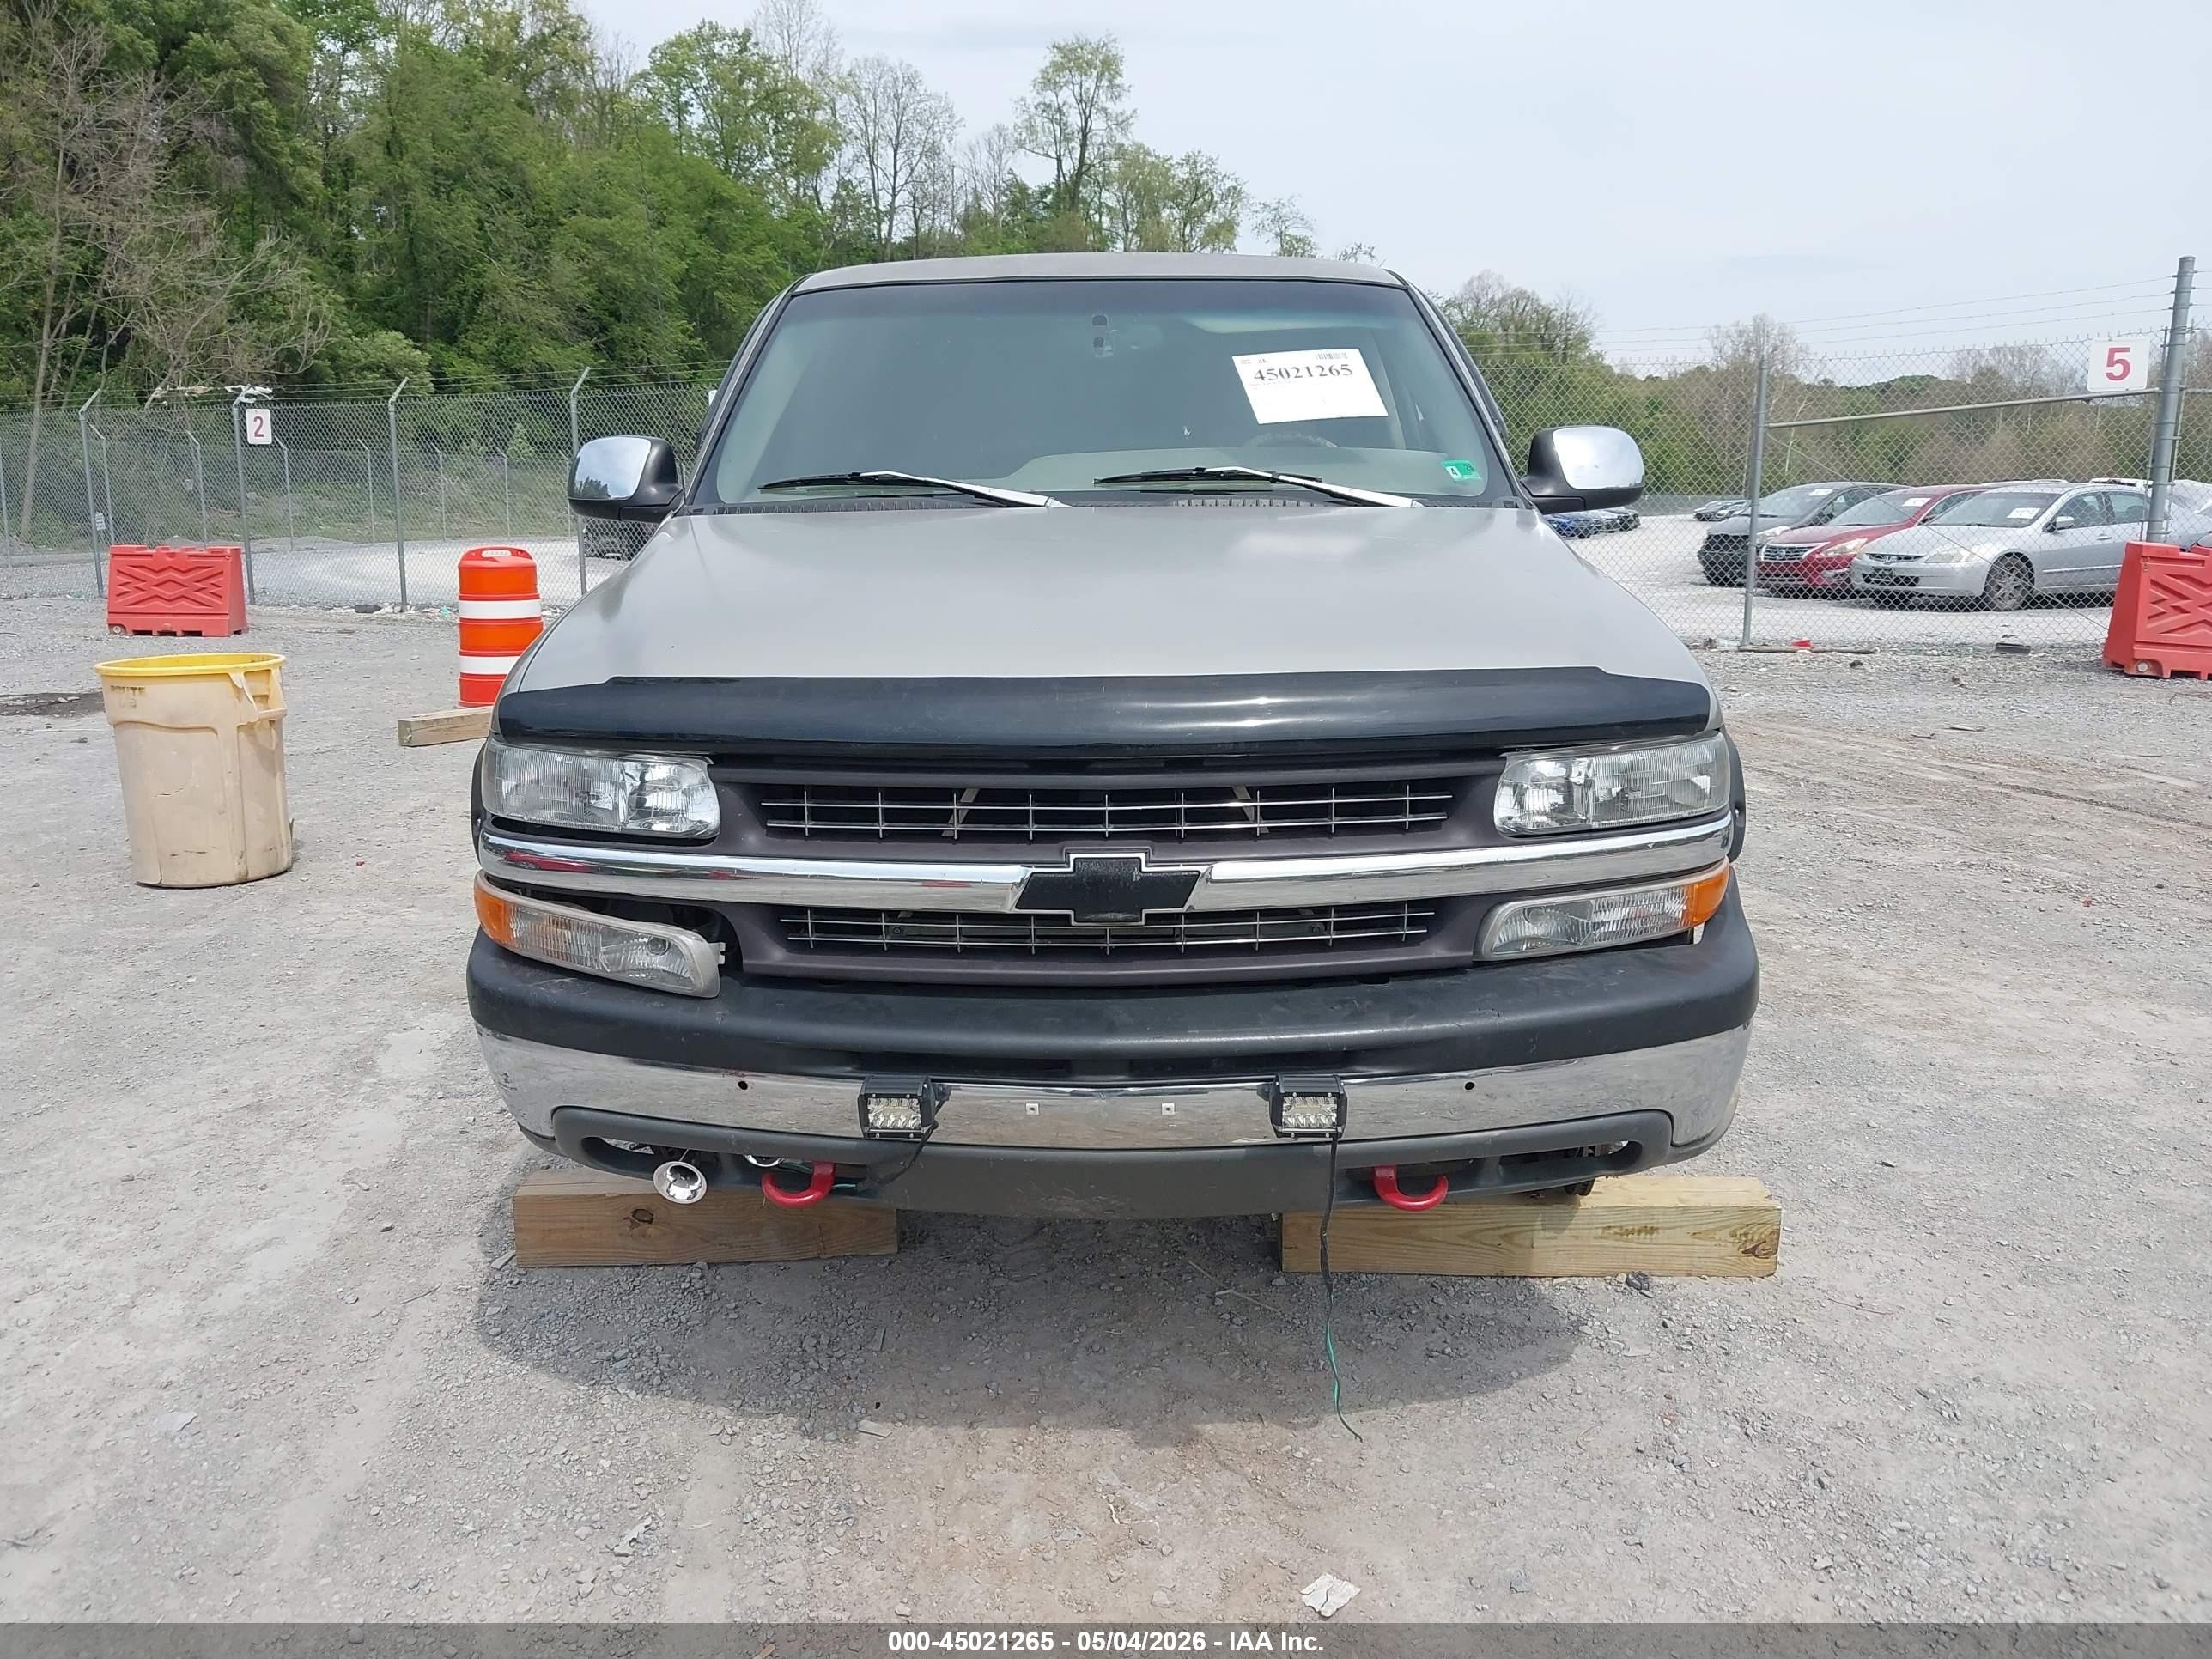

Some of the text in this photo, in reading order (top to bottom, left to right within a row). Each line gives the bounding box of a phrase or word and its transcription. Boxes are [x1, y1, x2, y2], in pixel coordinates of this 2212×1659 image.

[1254, 364, 1353, 381] 45021265
[2106, 347, 2130, 380] 5
[253, 416, 264, 438] 2
